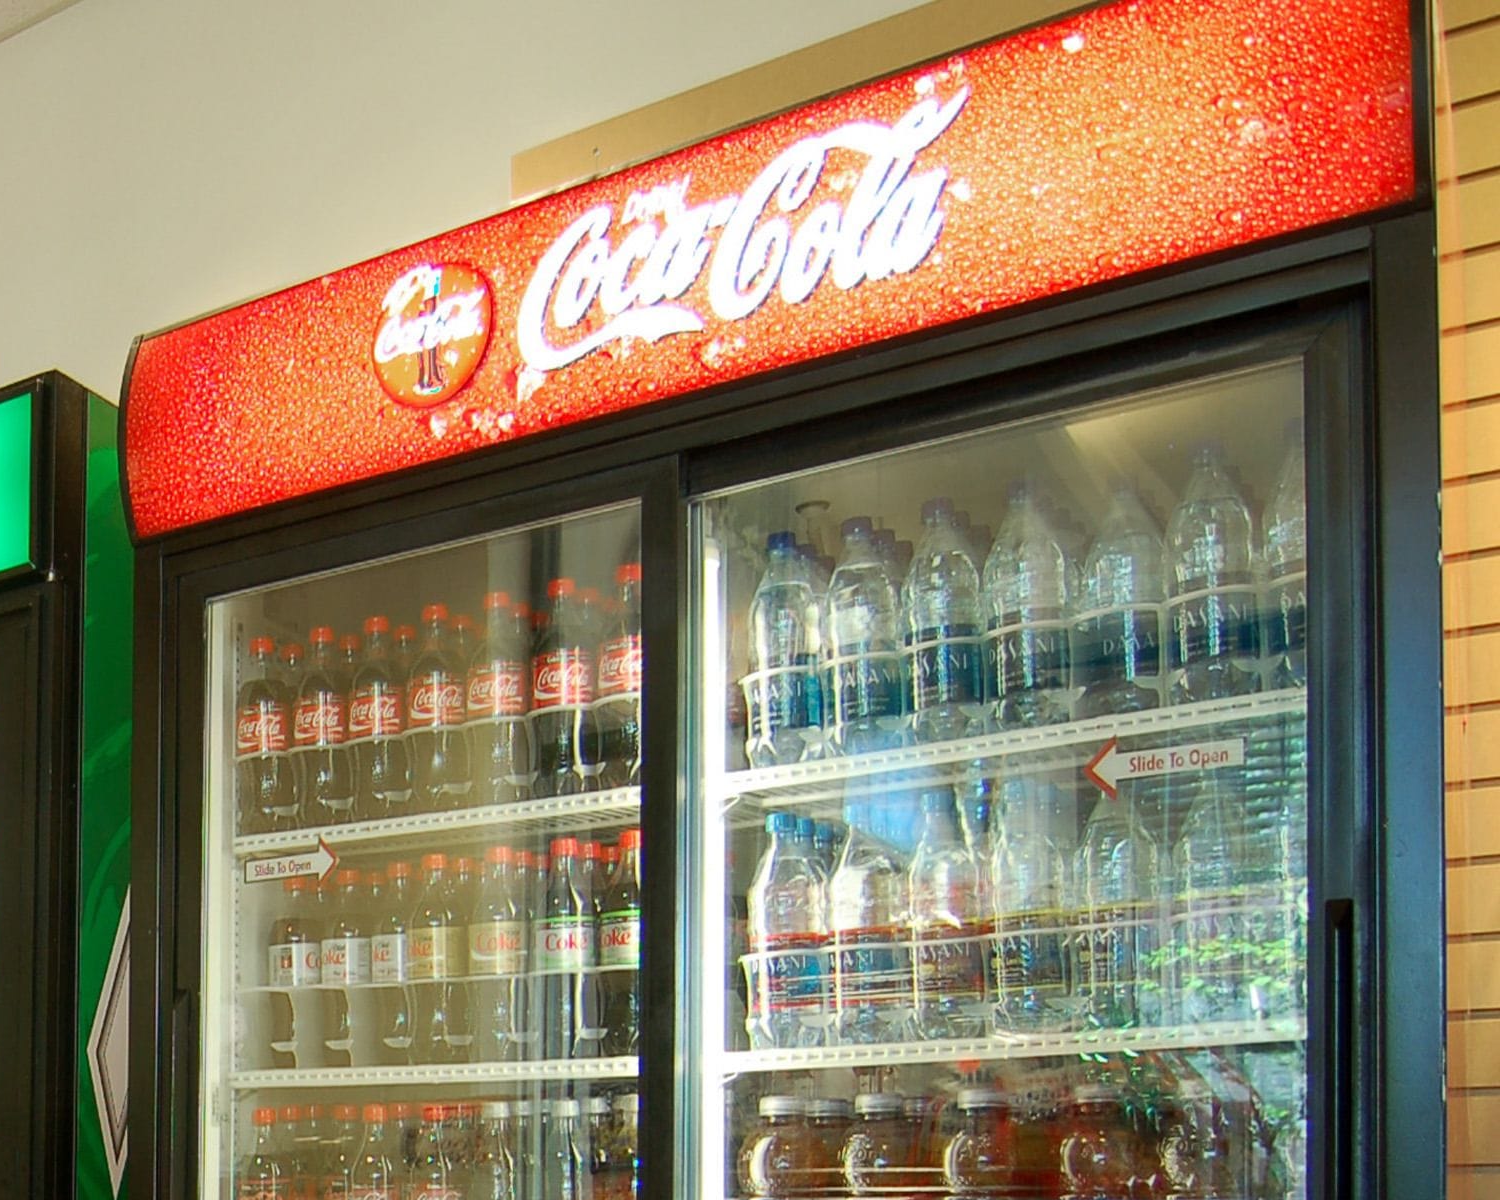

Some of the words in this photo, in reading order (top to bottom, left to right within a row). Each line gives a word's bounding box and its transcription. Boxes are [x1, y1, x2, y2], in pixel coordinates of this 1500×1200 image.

[517, 87, 972, 371] Coca-Cola
[1129, 752, 1164, 772] Slide
[1169, 750, 1185, 768] To
[1189, 746, 1229, 769] Open
[254, 863, 275, 876] Slide
[277, 862, 287, 873] To
[288, 860, 312, 874] Open
[475, 931, 520, 954] Coke
[545, 932, 588, 952] Coke
[601, 927, 631, 947] oke
